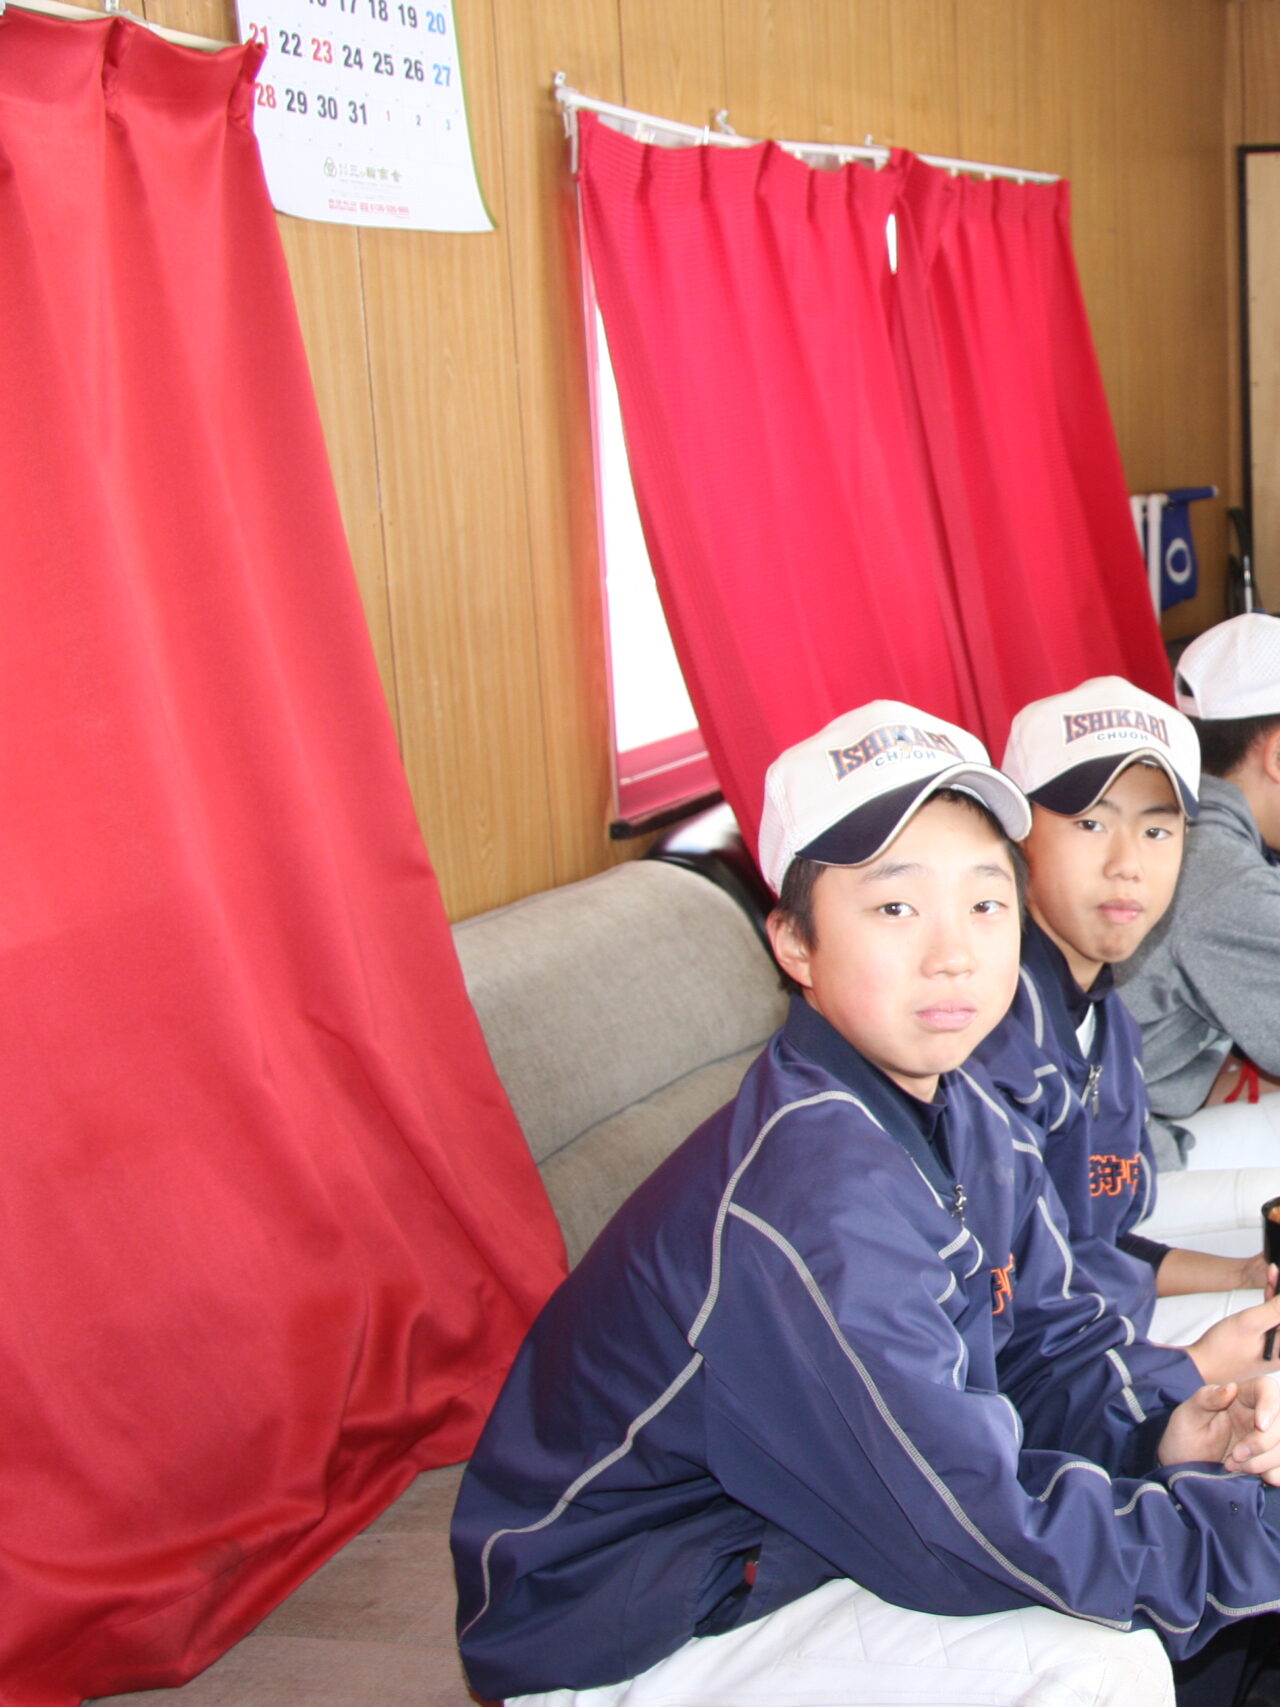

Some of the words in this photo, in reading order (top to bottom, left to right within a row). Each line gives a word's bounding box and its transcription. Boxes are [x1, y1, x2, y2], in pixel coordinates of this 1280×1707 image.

[368, 0, 389, 22] 18
[397, 4, 418, 28] 19
[425, 10, 446, 35] 20
[249, 22, 269, 50] 21
[279, 30, 303, 57] 22
[311, 37, 333, 64] 23
[342, 44, 364, 70] 24
[372, 51, 394, 76] 25
[403, 57, 424, 82] 26
[432, 63, 451, 87] 27
[254, 82, 277, 109] 28
[285, 88, 308, 115] 29
[316, 94, 338, 120] 30
[348, 100, 368, 125] 31
[386, 109, 391, 122] 1
[416, 114, 422, 127] 2
[1063, 708, 1171, 749] ISHIKARI
[1096, 730, 1149, 742] CHUOH
[828, 724, 967, 781] ISHIKARI
